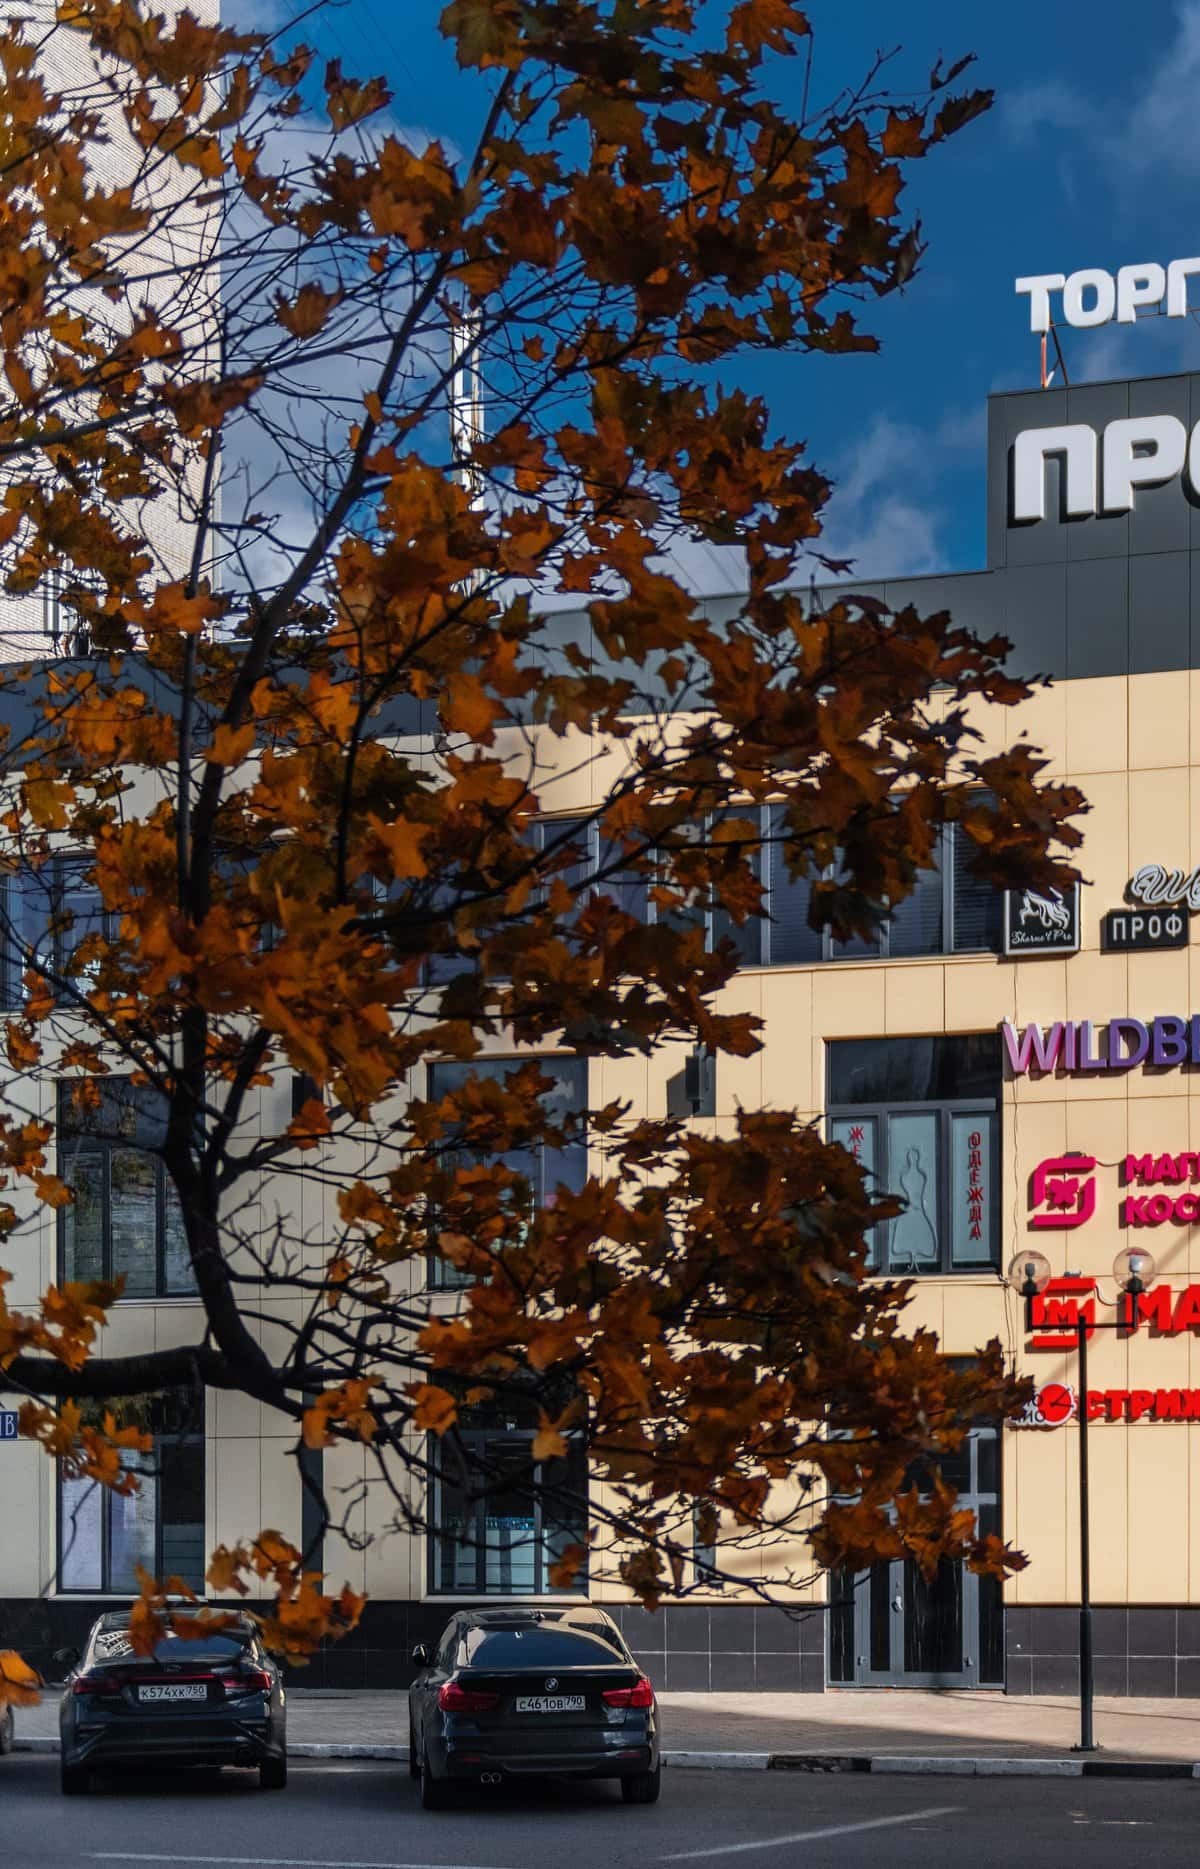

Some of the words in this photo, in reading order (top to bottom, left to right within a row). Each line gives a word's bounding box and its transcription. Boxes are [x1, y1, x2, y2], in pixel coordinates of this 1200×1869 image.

[1112, 913, 1183, 942] ПРОФ
[967, 1131, 984, 1241] ОДЕЖДА
[0, 1414, 15, 1436] В
